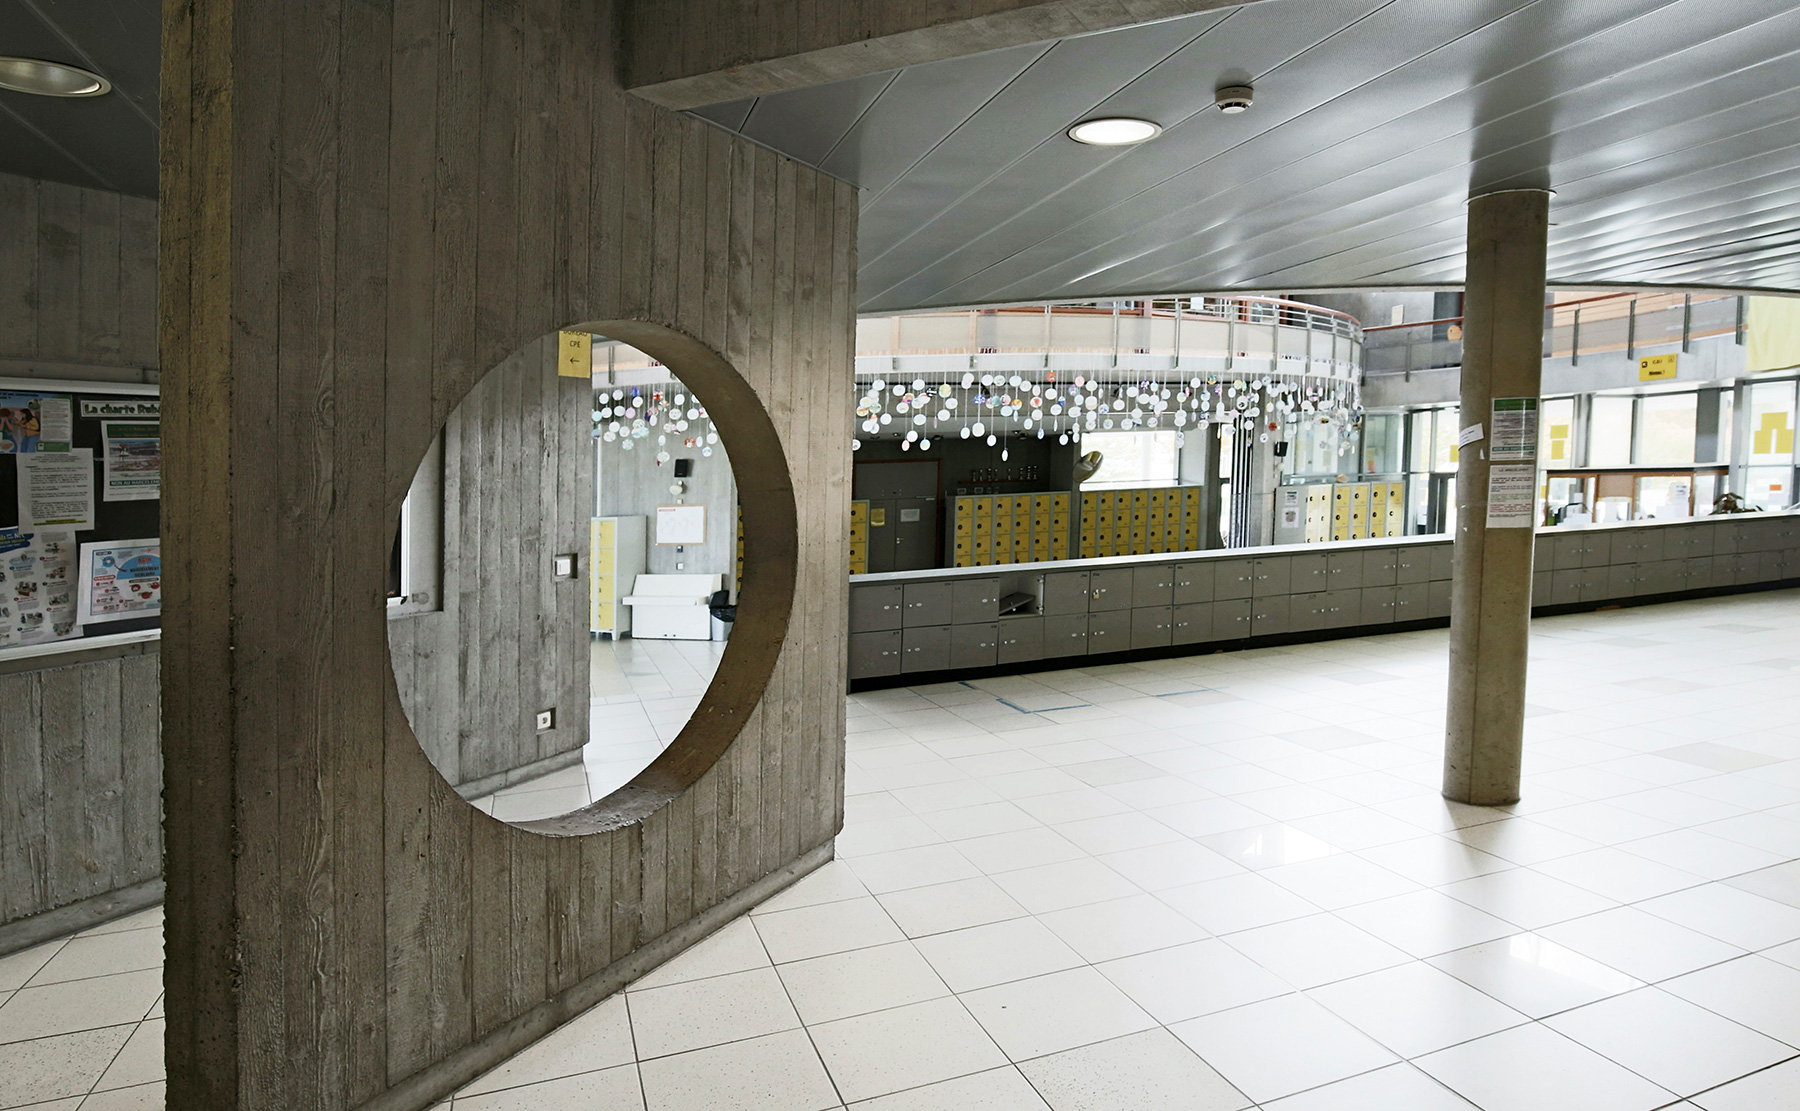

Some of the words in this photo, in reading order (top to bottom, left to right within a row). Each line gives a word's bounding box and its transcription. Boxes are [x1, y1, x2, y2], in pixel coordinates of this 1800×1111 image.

[569, 340, 581, 348] CPE
[84, 404, 98, 413] La
[100, 403, 136, 413] charte
